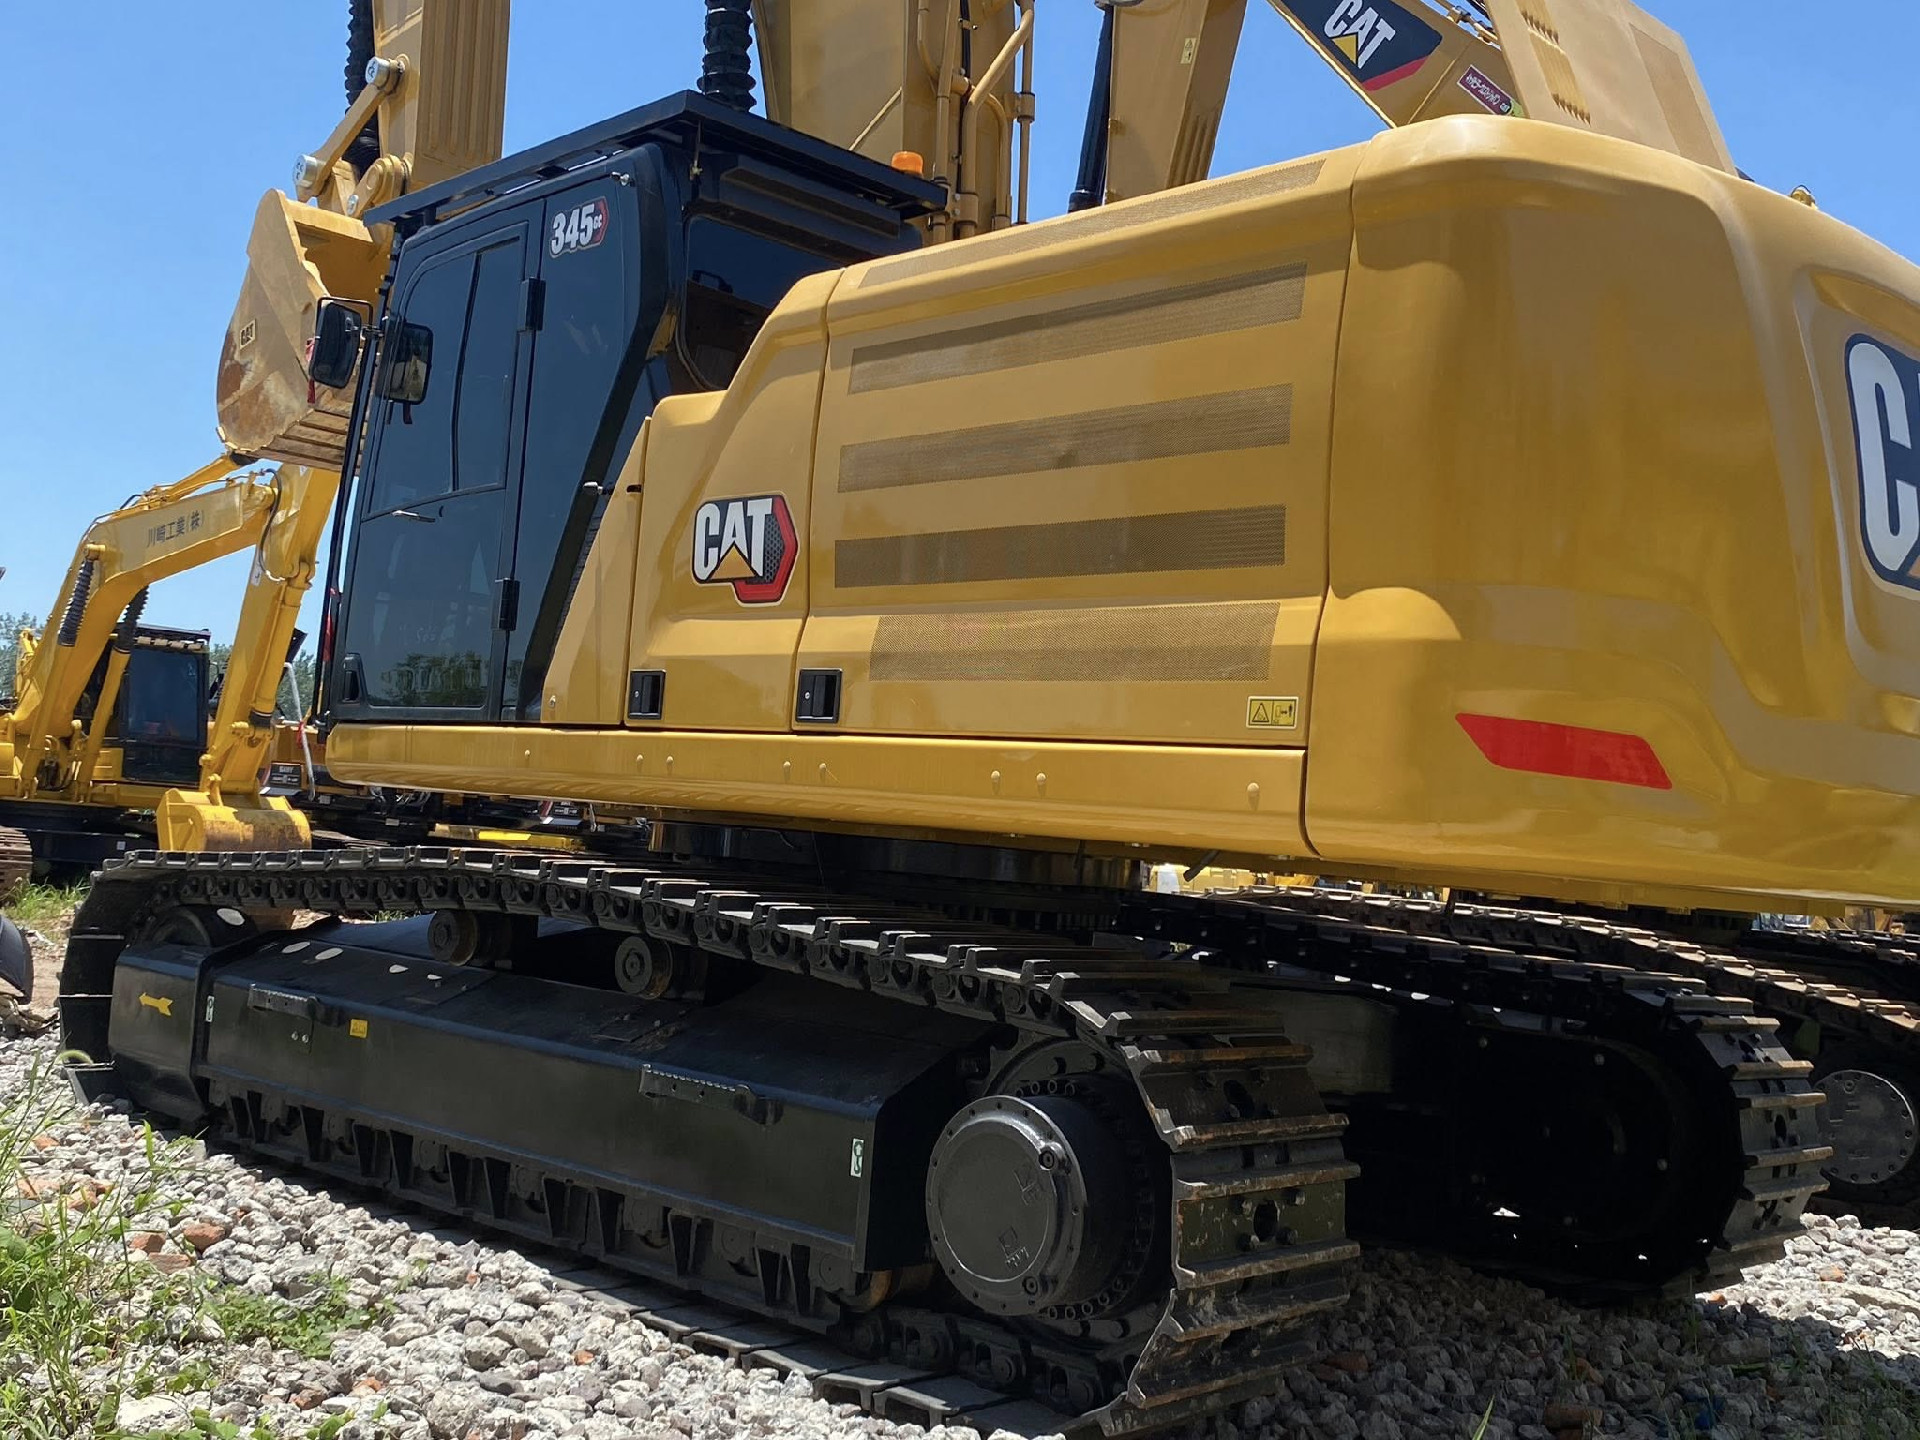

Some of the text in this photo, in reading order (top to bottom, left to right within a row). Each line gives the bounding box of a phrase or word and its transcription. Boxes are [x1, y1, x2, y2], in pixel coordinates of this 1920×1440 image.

[1324, 0, 1396, 69] CAT
[551, 203, 595, 255] 345
[1849, 343, 1920, 571] C
[694, 498, 773, 581] CAT
